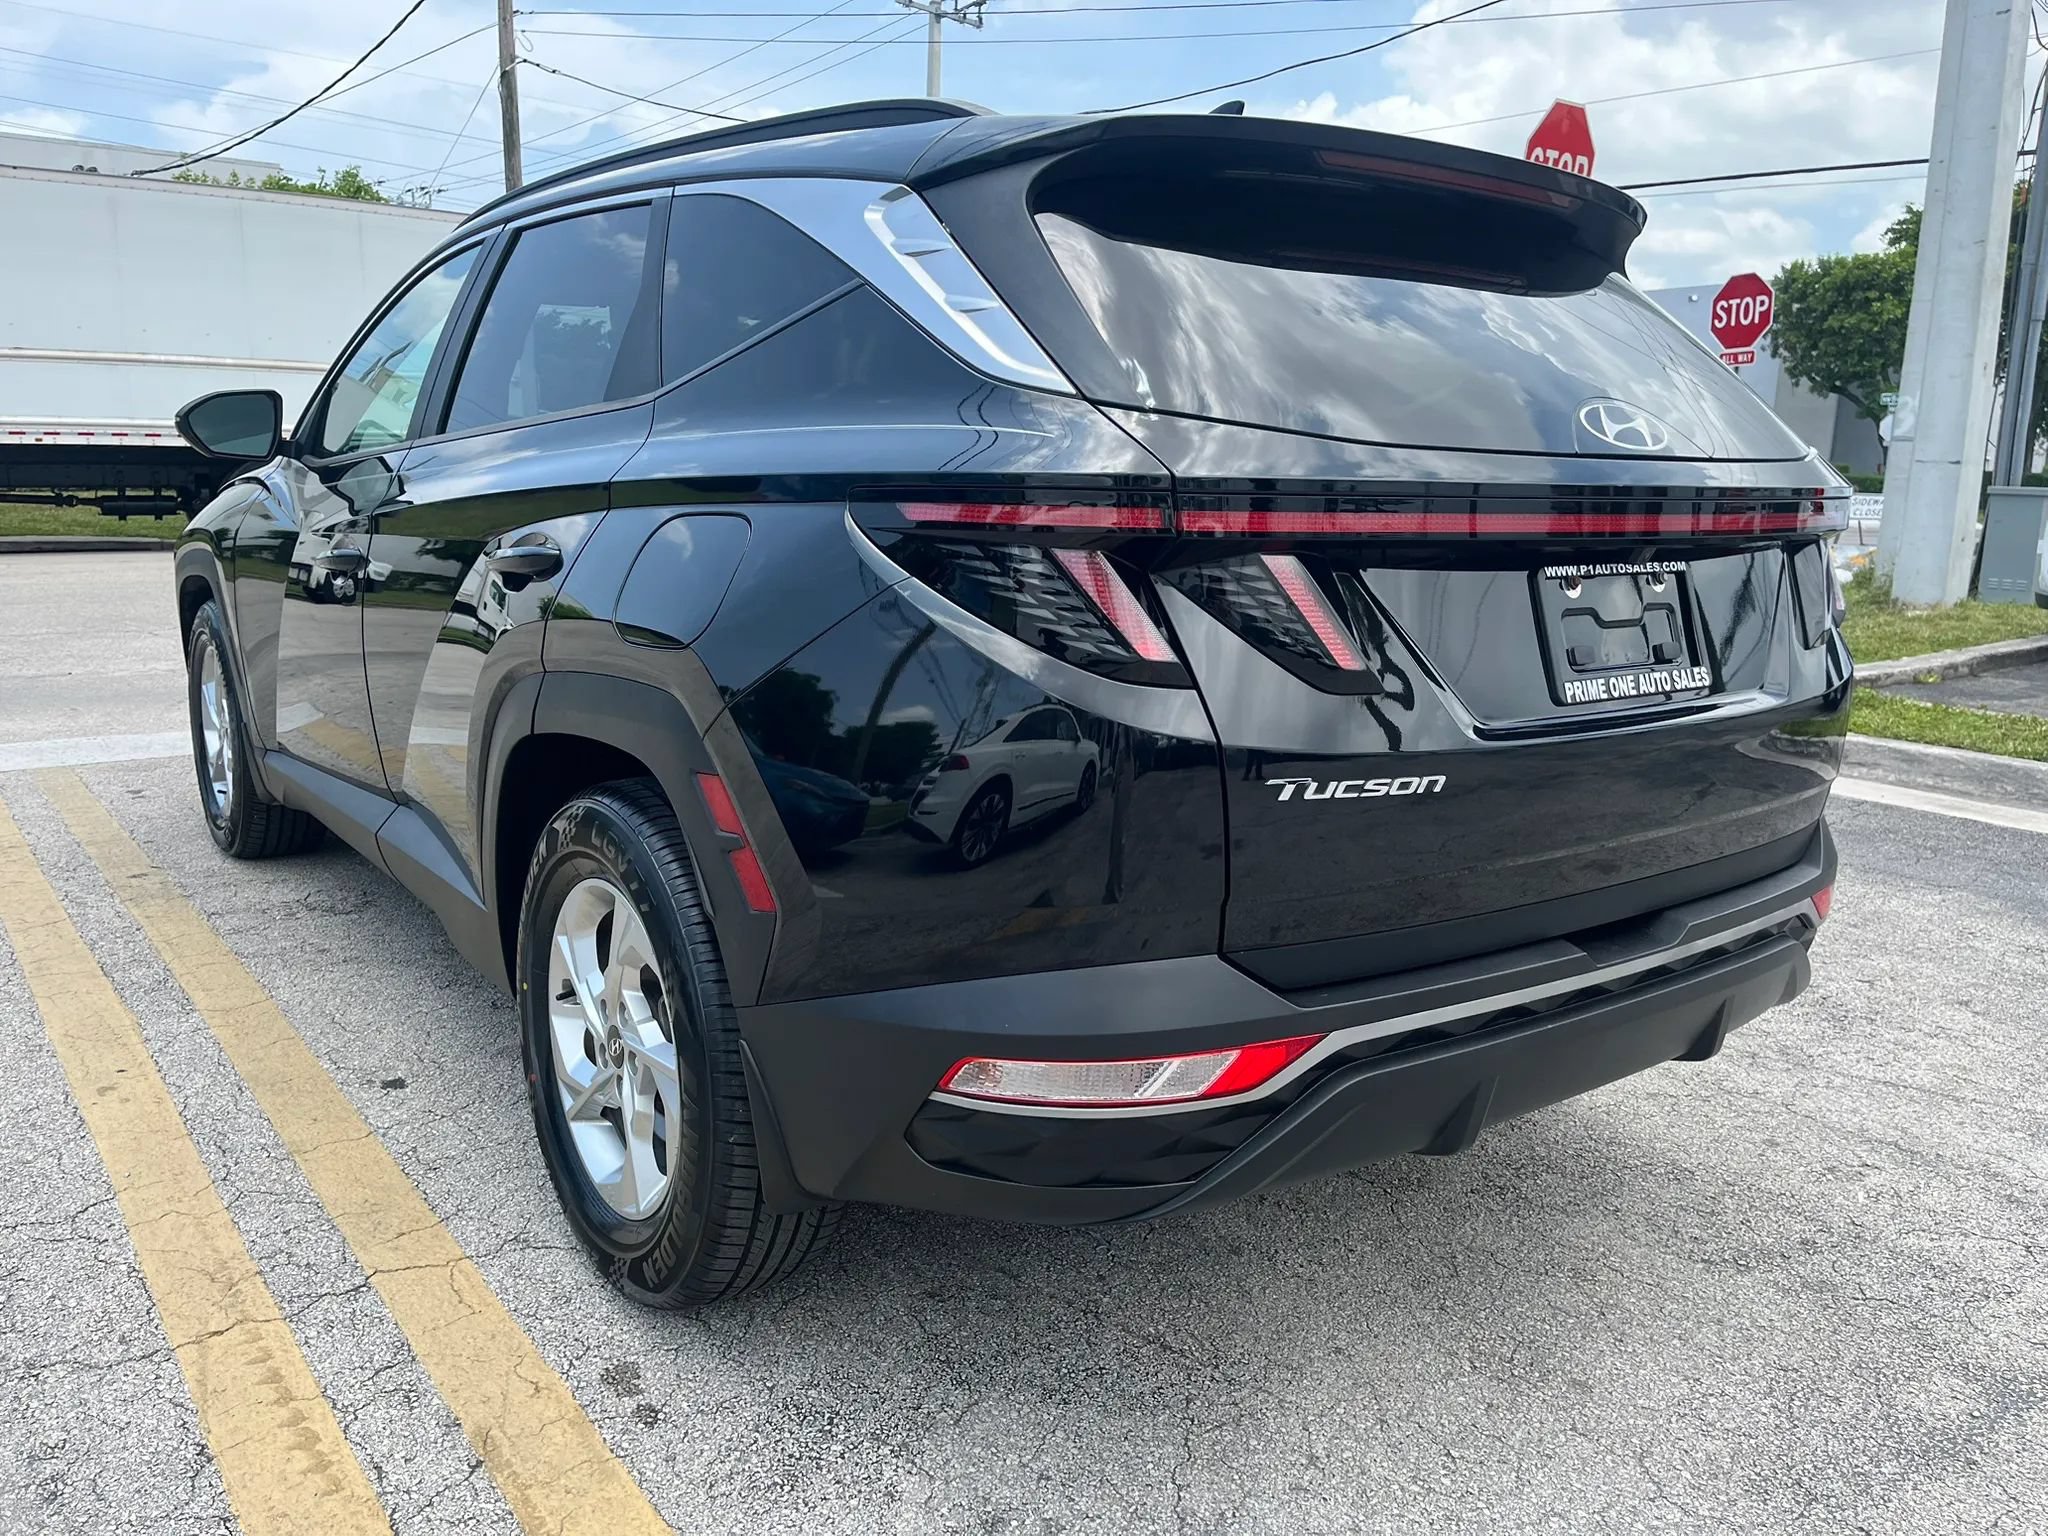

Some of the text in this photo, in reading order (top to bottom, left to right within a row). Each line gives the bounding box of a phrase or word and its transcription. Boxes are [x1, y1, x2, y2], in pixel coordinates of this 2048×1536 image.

[1713, 295, 1770, 329] STOP
[1738, 352, 1753, 363] WAY
[1544, 561, 1687, 577] WWW.P1AUTOSALES.COM
[1564, 666, 1710, 703] PRIME ONE AUTO SALES
